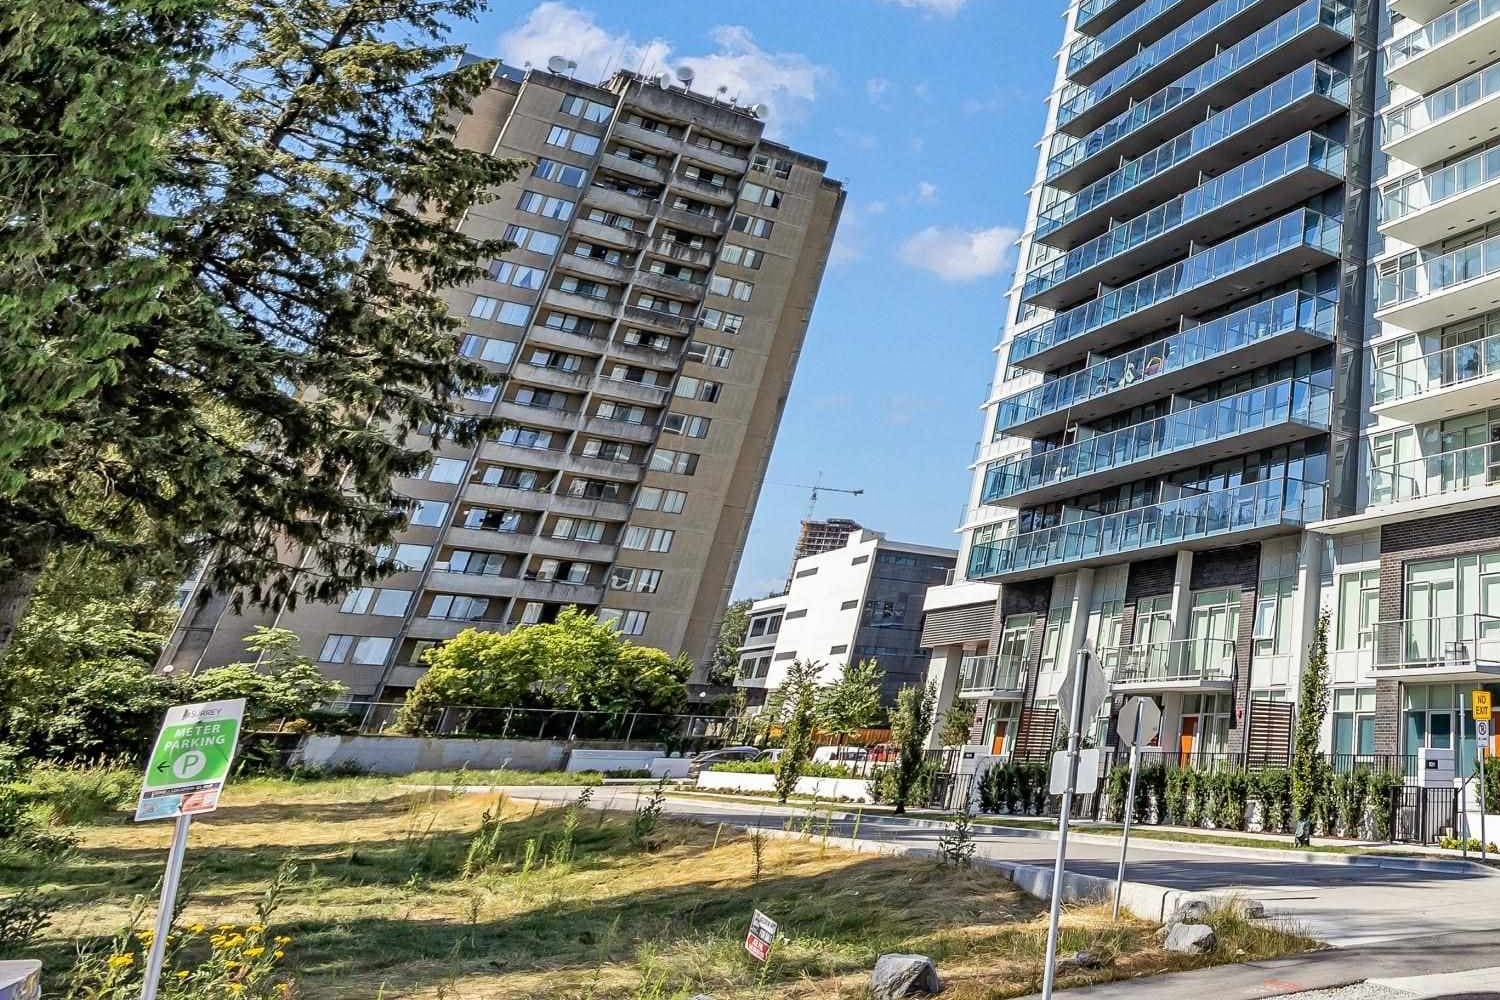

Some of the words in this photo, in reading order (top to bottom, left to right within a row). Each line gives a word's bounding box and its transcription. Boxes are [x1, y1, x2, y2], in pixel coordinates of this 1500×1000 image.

[1477, 695, 1486, 704] NO
[191, 708, 223, 717] SRREY
[1476, 706, 1488, 715] EXIT
[175, 724, 221, 737] METER
[163, 735, 225, 751] PARKING
[181, 754, 199, 775] P
